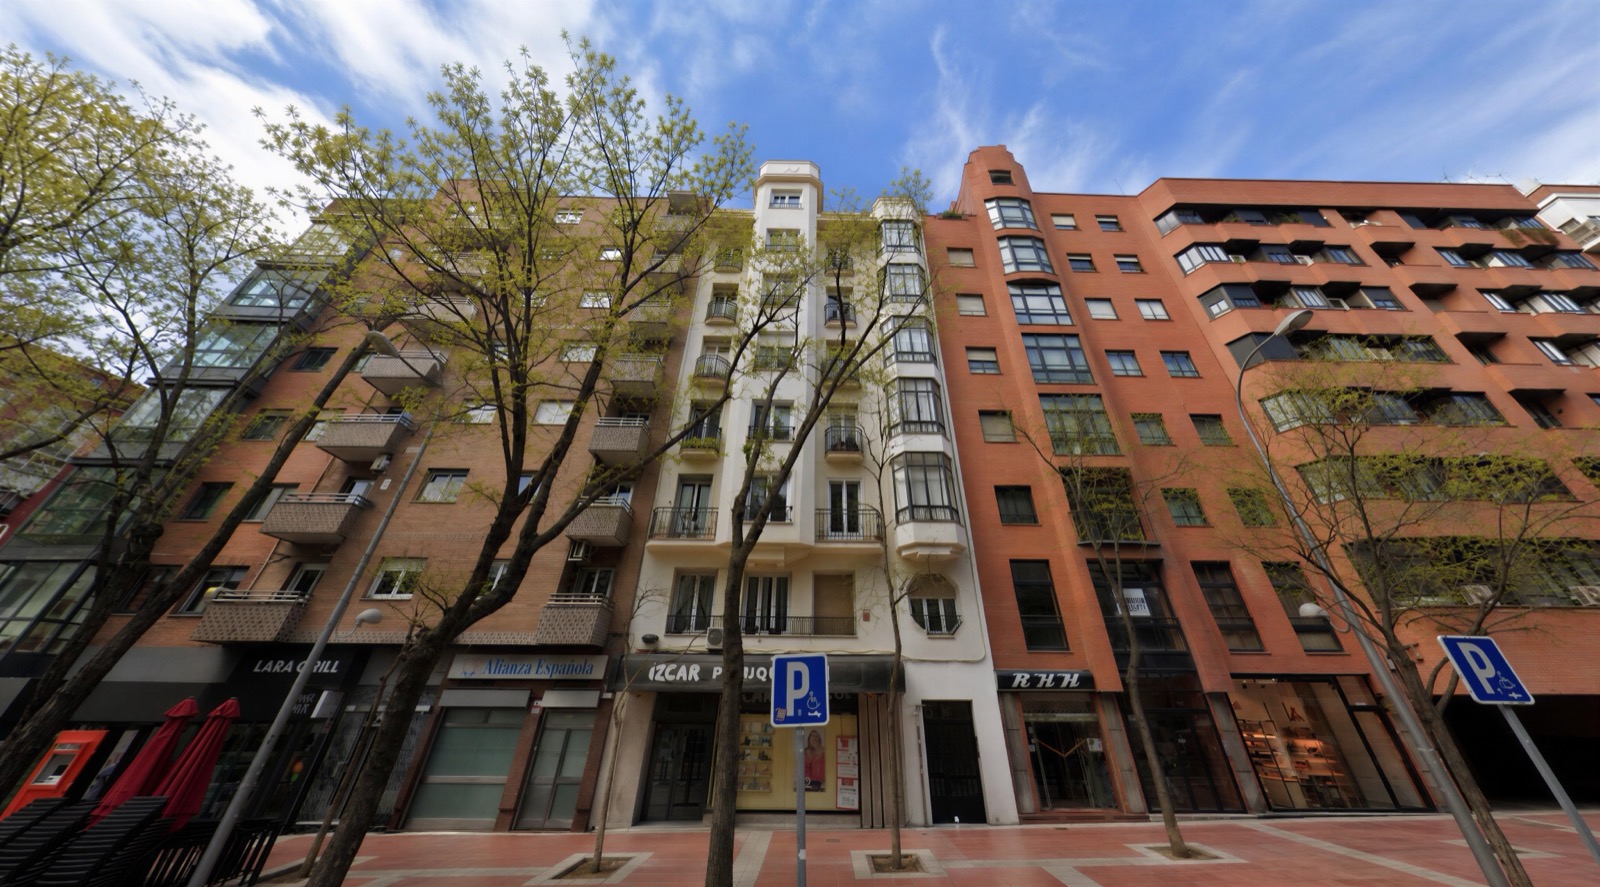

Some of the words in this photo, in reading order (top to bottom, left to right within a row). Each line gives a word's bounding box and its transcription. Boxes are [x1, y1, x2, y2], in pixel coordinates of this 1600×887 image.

[252, 660, 295, 673] LARA
[482, 659, 532, 675] Alianza
[535, 659, 594, 678] Española
[1456, 642, 1496, 694] P
[786, 661, 810, 717] P
